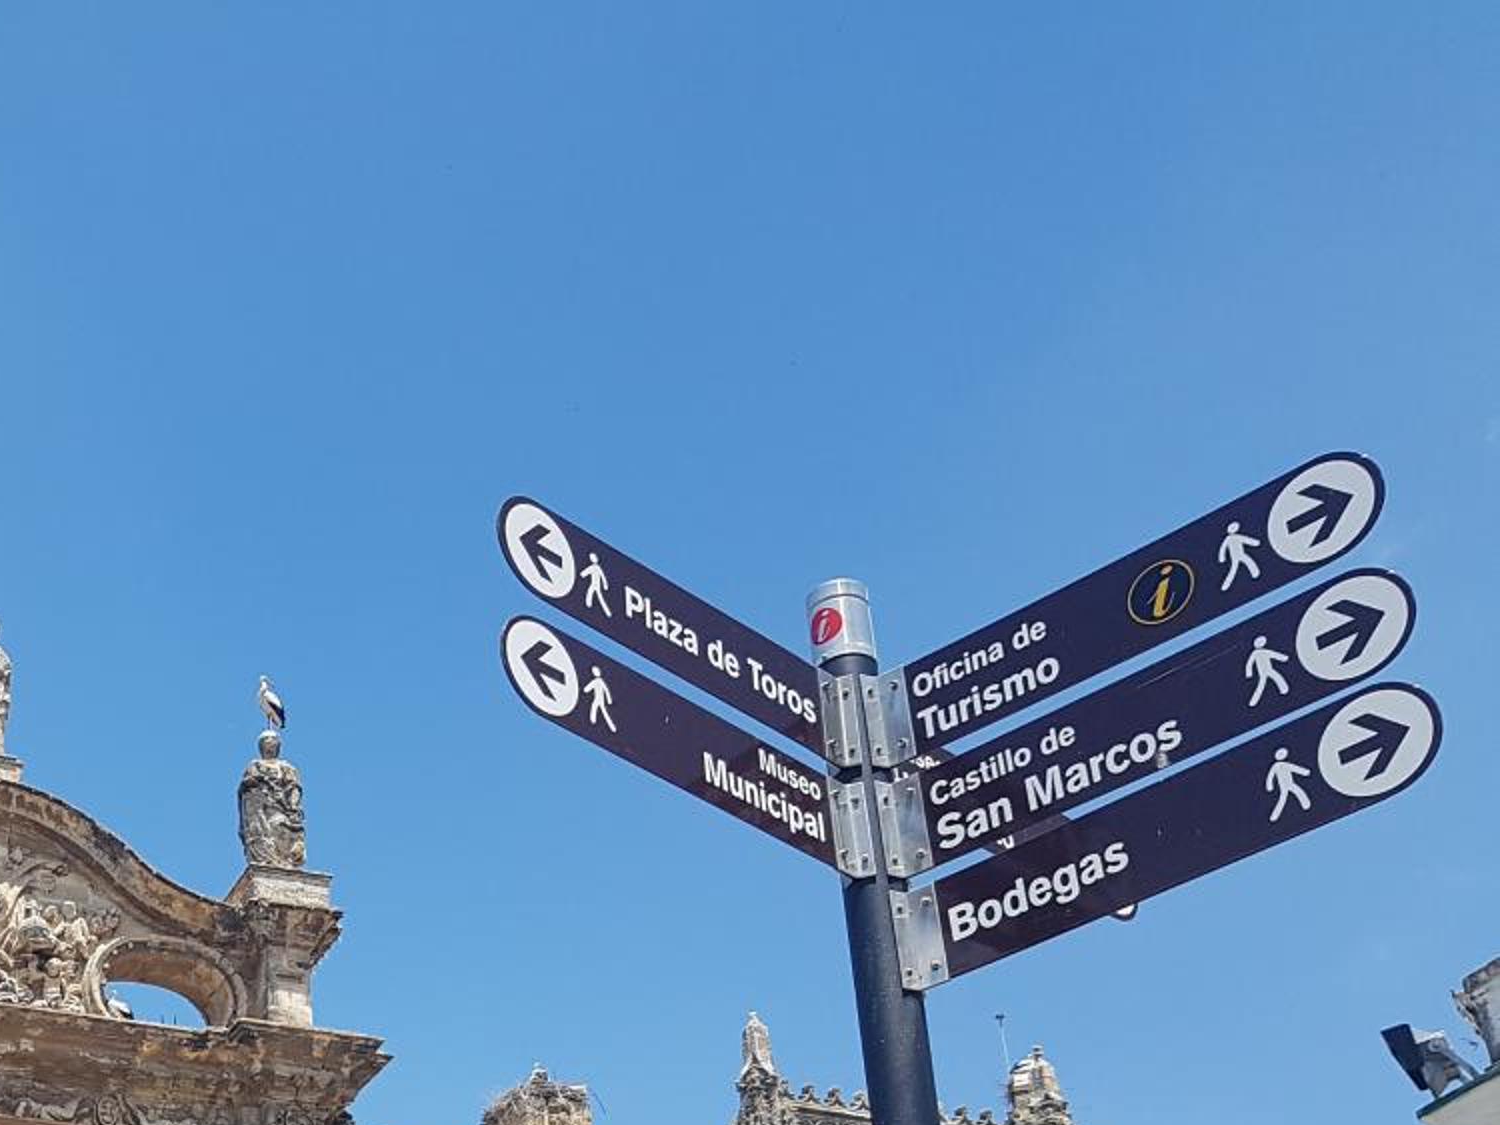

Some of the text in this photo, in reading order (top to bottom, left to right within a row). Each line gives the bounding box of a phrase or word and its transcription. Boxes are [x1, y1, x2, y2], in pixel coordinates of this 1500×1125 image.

[624, 585, 818, 724] Plaza de Toros
[911, 618, 1048, 698] Oficina de
[916, 655, 1061, 741] Turismo
[702, 751, 827, 843] Municipal
[757, 748, 822, 801] Museo
[929, 746, 1032, 805] Castillo
[1039, 724, 1077, 763] de
[936, 718, 1183, 850] San Marcos
[946, 838, 1131, 943] Bodegas
